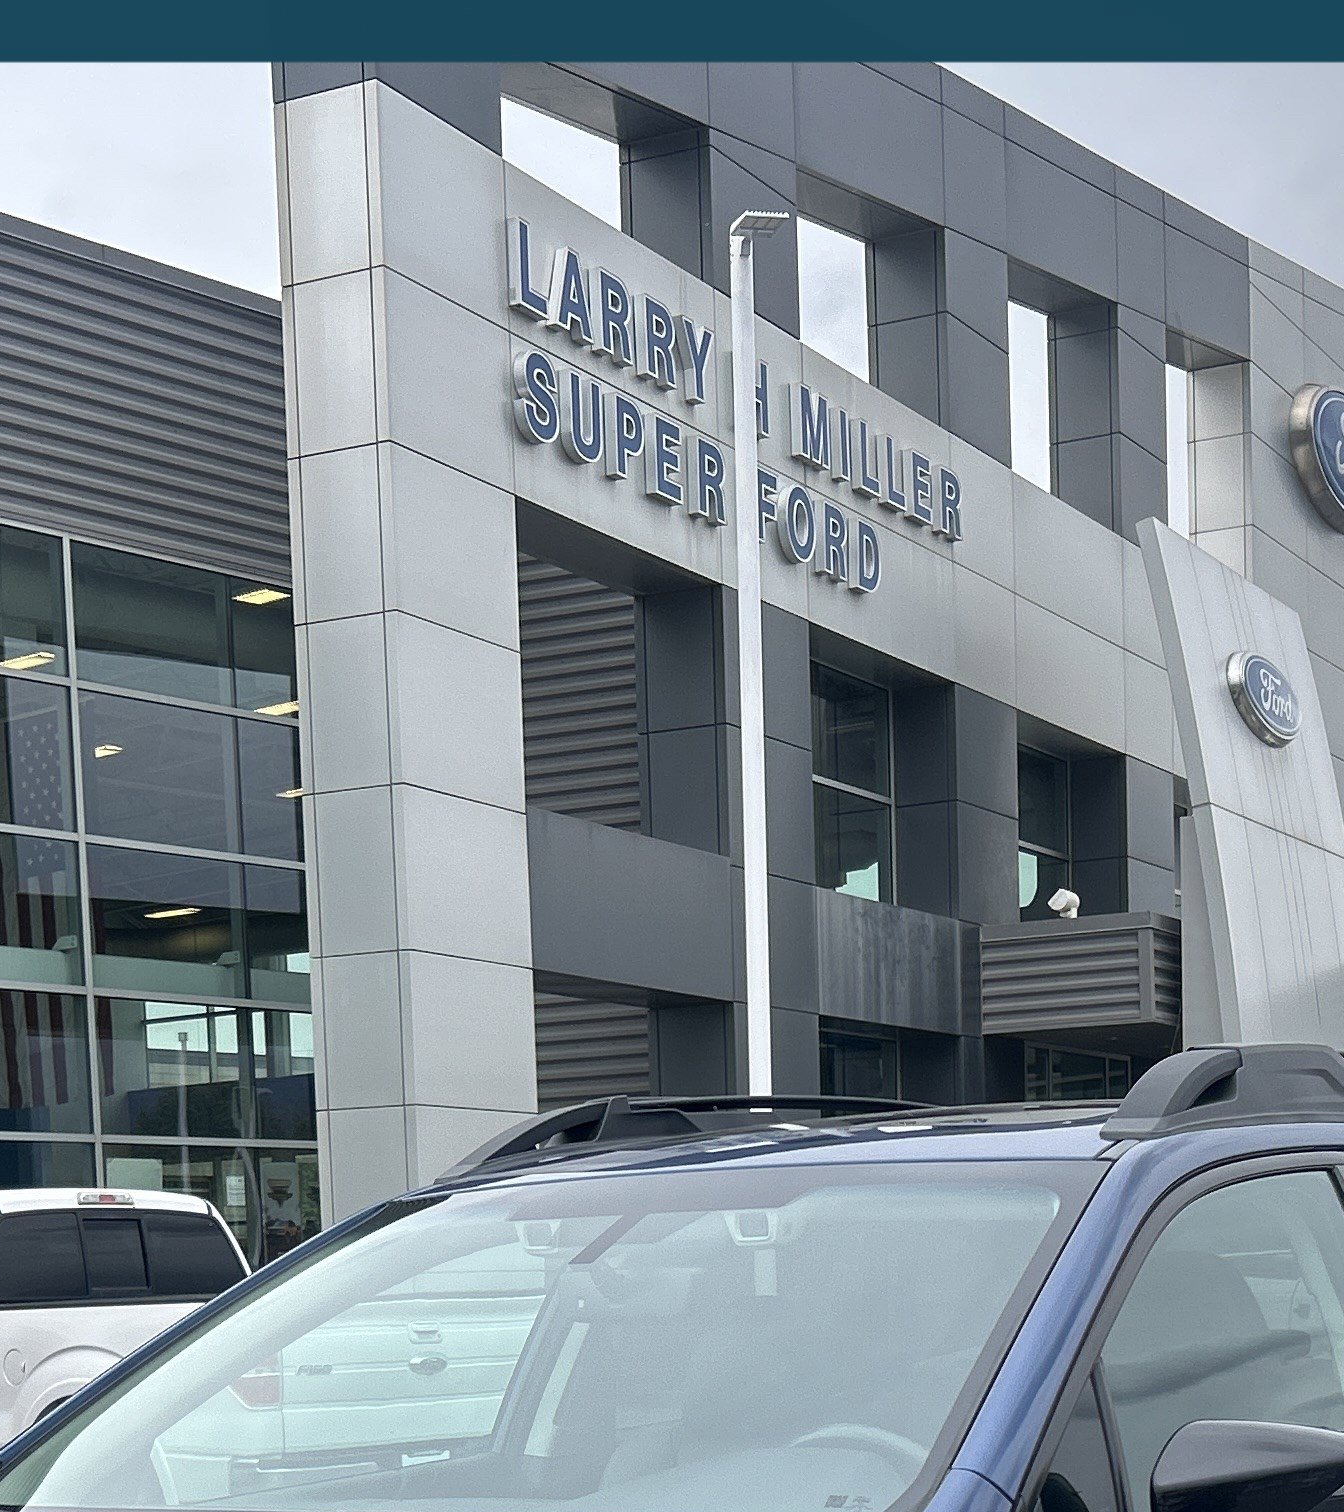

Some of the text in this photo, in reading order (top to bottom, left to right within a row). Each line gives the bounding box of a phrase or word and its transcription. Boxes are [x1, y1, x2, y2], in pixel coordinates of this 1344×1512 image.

[511, 217, 714, 404] LARRY
[788, 380, 963, 542] MILLER
[516, 350, 882, 593] SUPER FORD
[1258, 667, 1294, 723] Ford
